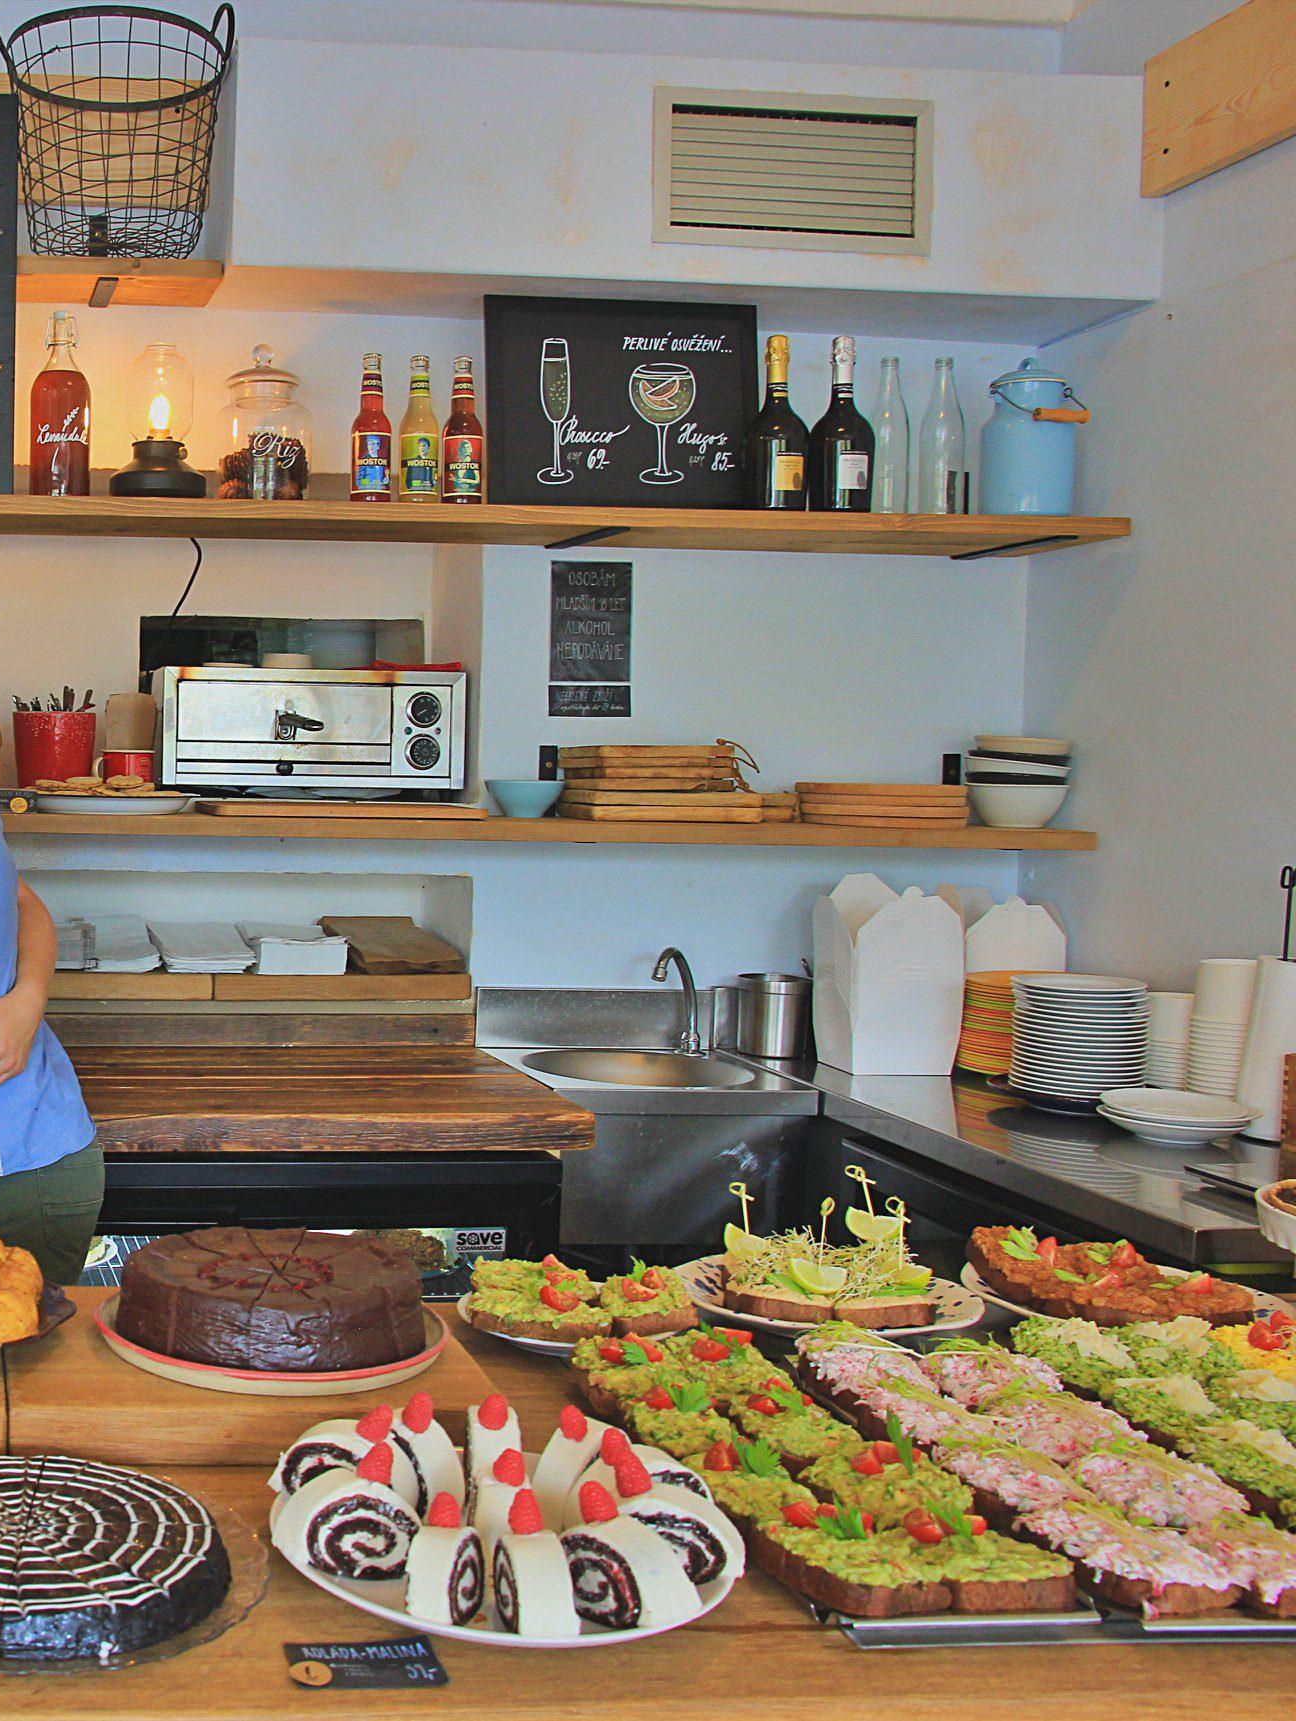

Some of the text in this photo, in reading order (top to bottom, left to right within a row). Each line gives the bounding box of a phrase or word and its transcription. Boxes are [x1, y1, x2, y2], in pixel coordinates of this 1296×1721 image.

[622, 331, 672, 351] PERLIVÉ
[251, 432, 301, 470] Riz
[356, 457, 388, 466] WOSTOK
[406, 458, 437, 467] WOSTOK
[448, 462, 480, 471] WOSTOK
[564, 620, 616, 636] ALKOHOL
[456, 1231, 504, 1246] save
